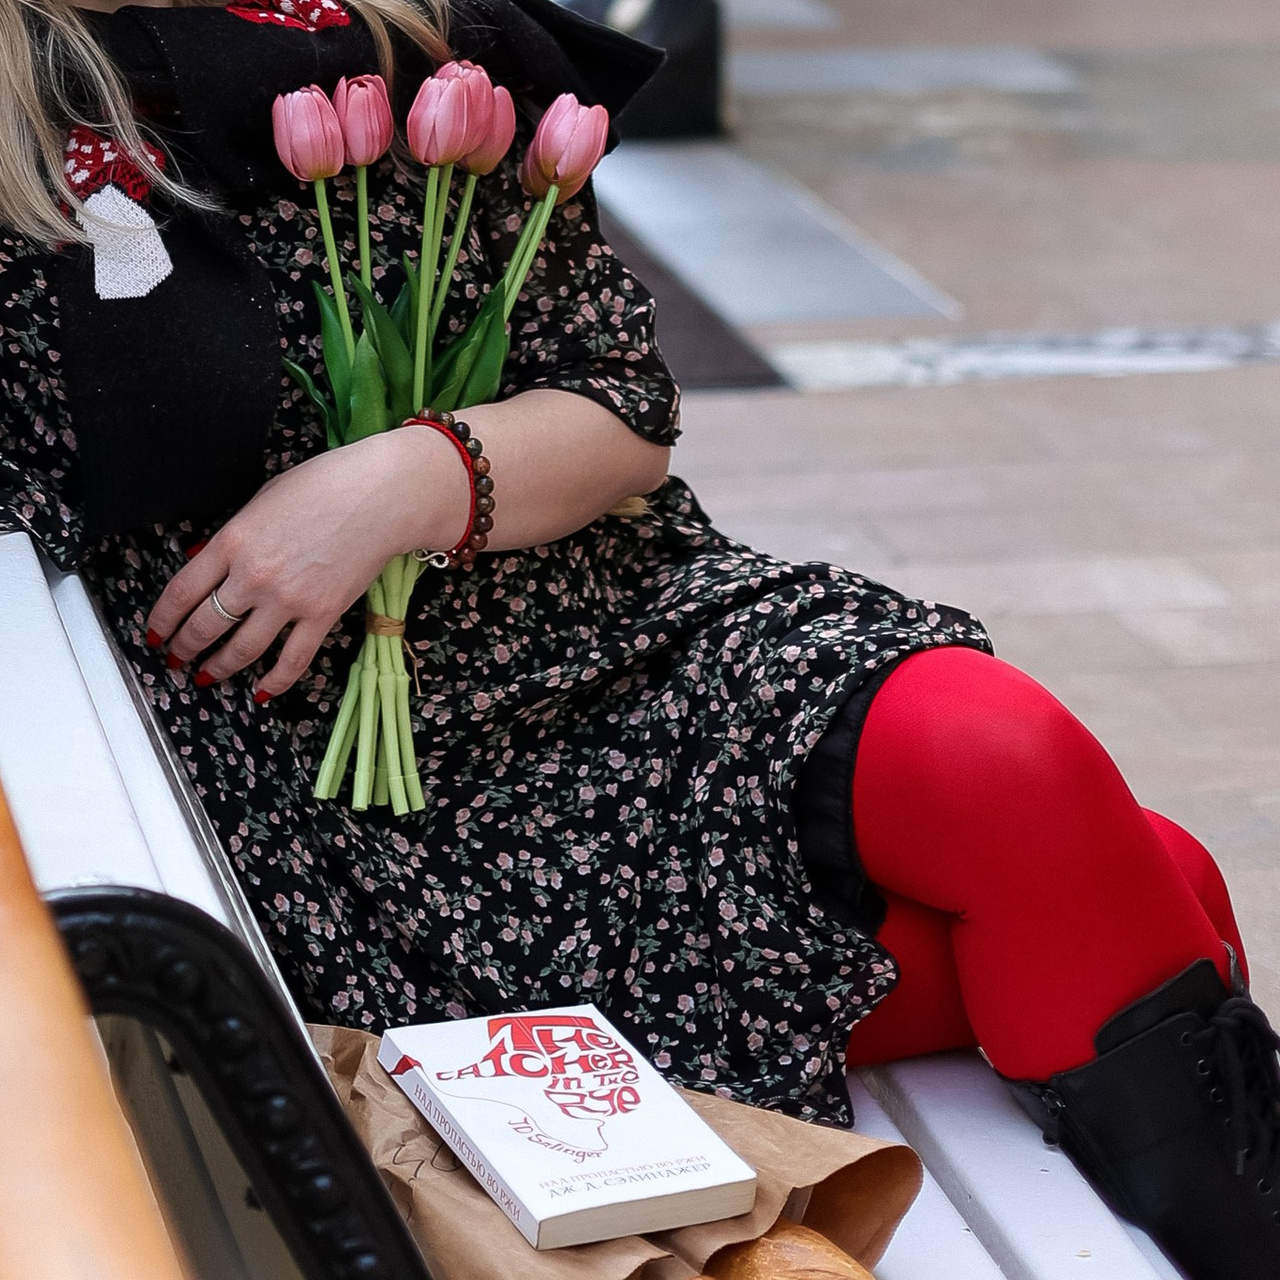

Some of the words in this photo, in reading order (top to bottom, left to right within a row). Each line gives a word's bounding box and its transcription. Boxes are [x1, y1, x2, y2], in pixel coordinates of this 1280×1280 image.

[413, 1084, 433, 1115] НАД
[433, 1107, 486, 1178] ПРОПАСТЬЮ
[486, 1172, 499, 1193] ВО
[500, 1188, 521, 1222] РЖИ
[528, 1133, 602, 1164] Salinger
